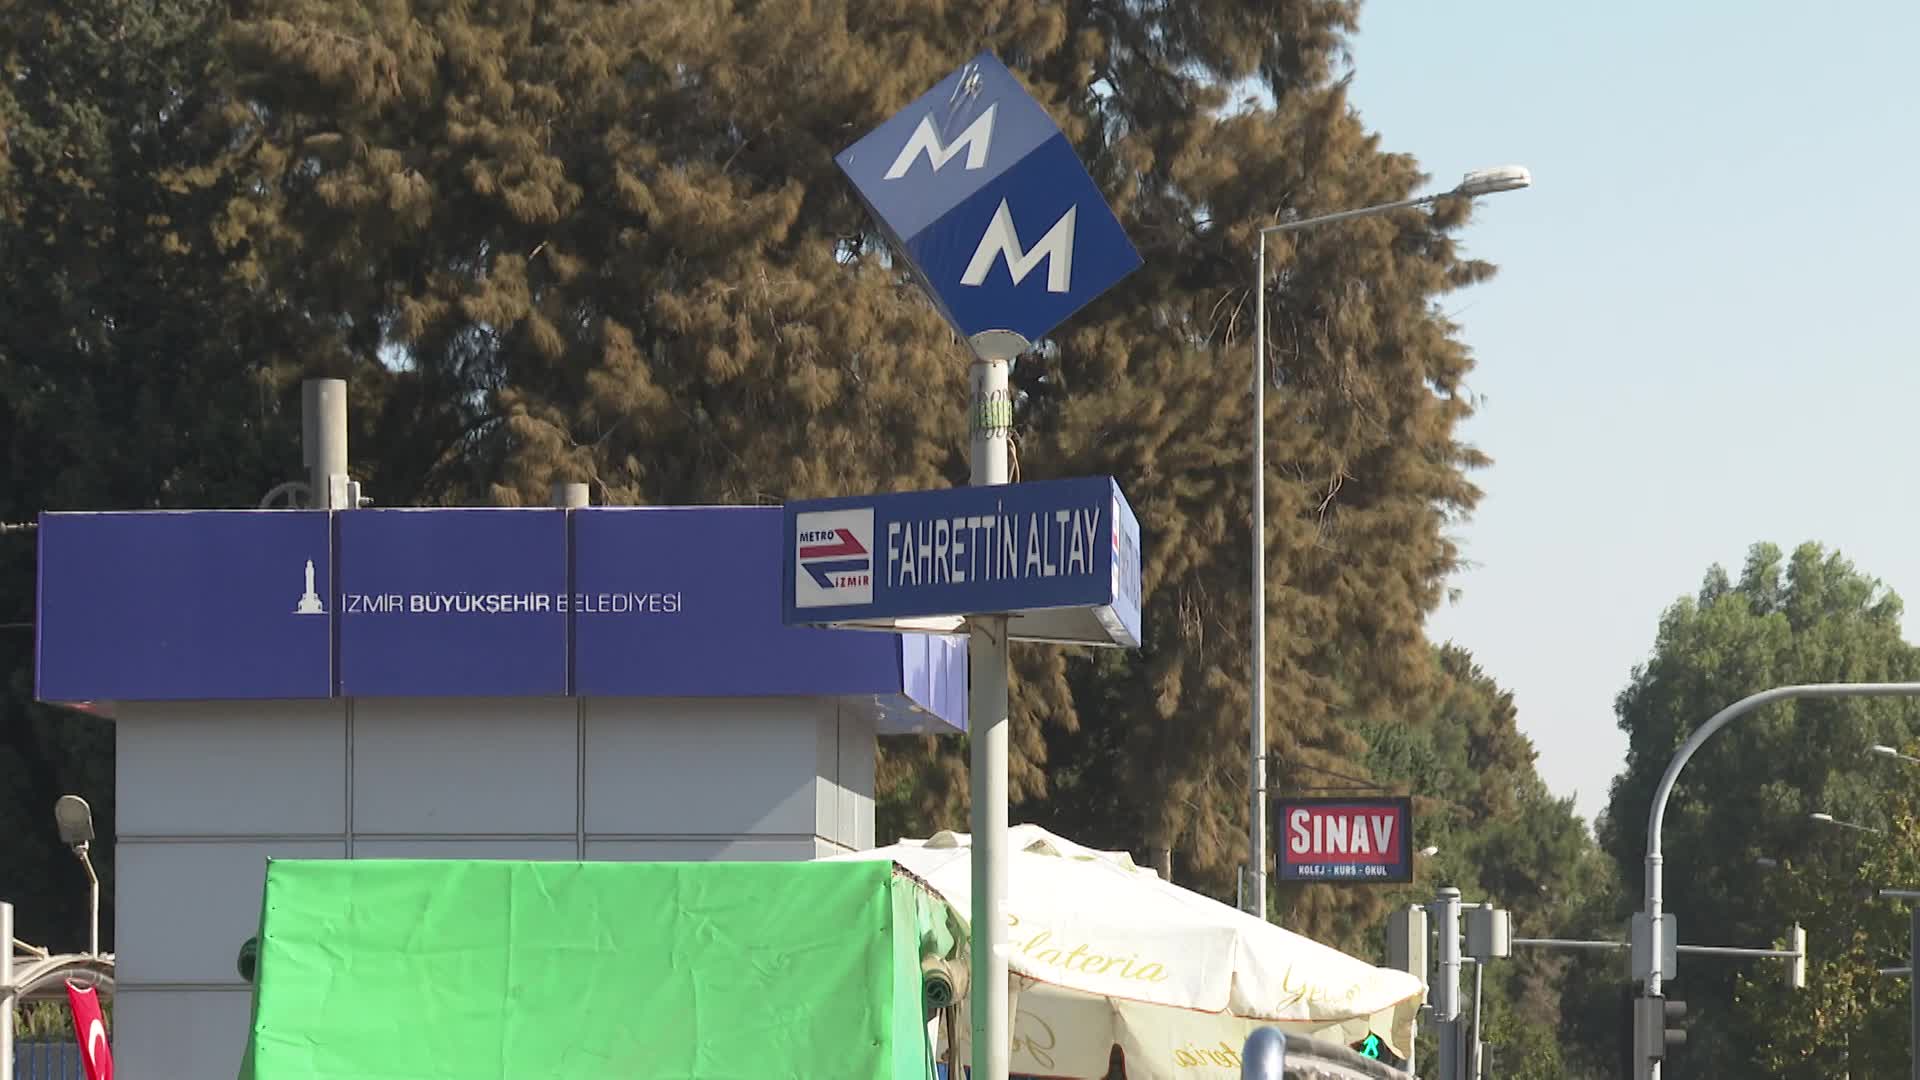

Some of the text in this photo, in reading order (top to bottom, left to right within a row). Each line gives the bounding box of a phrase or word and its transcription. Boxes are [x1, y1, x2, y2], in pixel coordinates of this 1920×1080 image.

[884, 102, 998, 180] M
[959, 196, 1077, 293] M
[799, 530, 834, 542] METRO
[887, 499, 1018, 588] FAHRETTİN
[1025, 505, 1100, 578] ALTAY
[342, 591, 681, 614] İZMİR BÜYÜKŞEHİR BELEDİYESİ
[1290, 809, 1394, 854] SINAV
[1298, 865, 1325, 876] KOLEJ
[1333, 865, 1357, 876] KURS
[1364, 865, 1388, 876] OKUL
